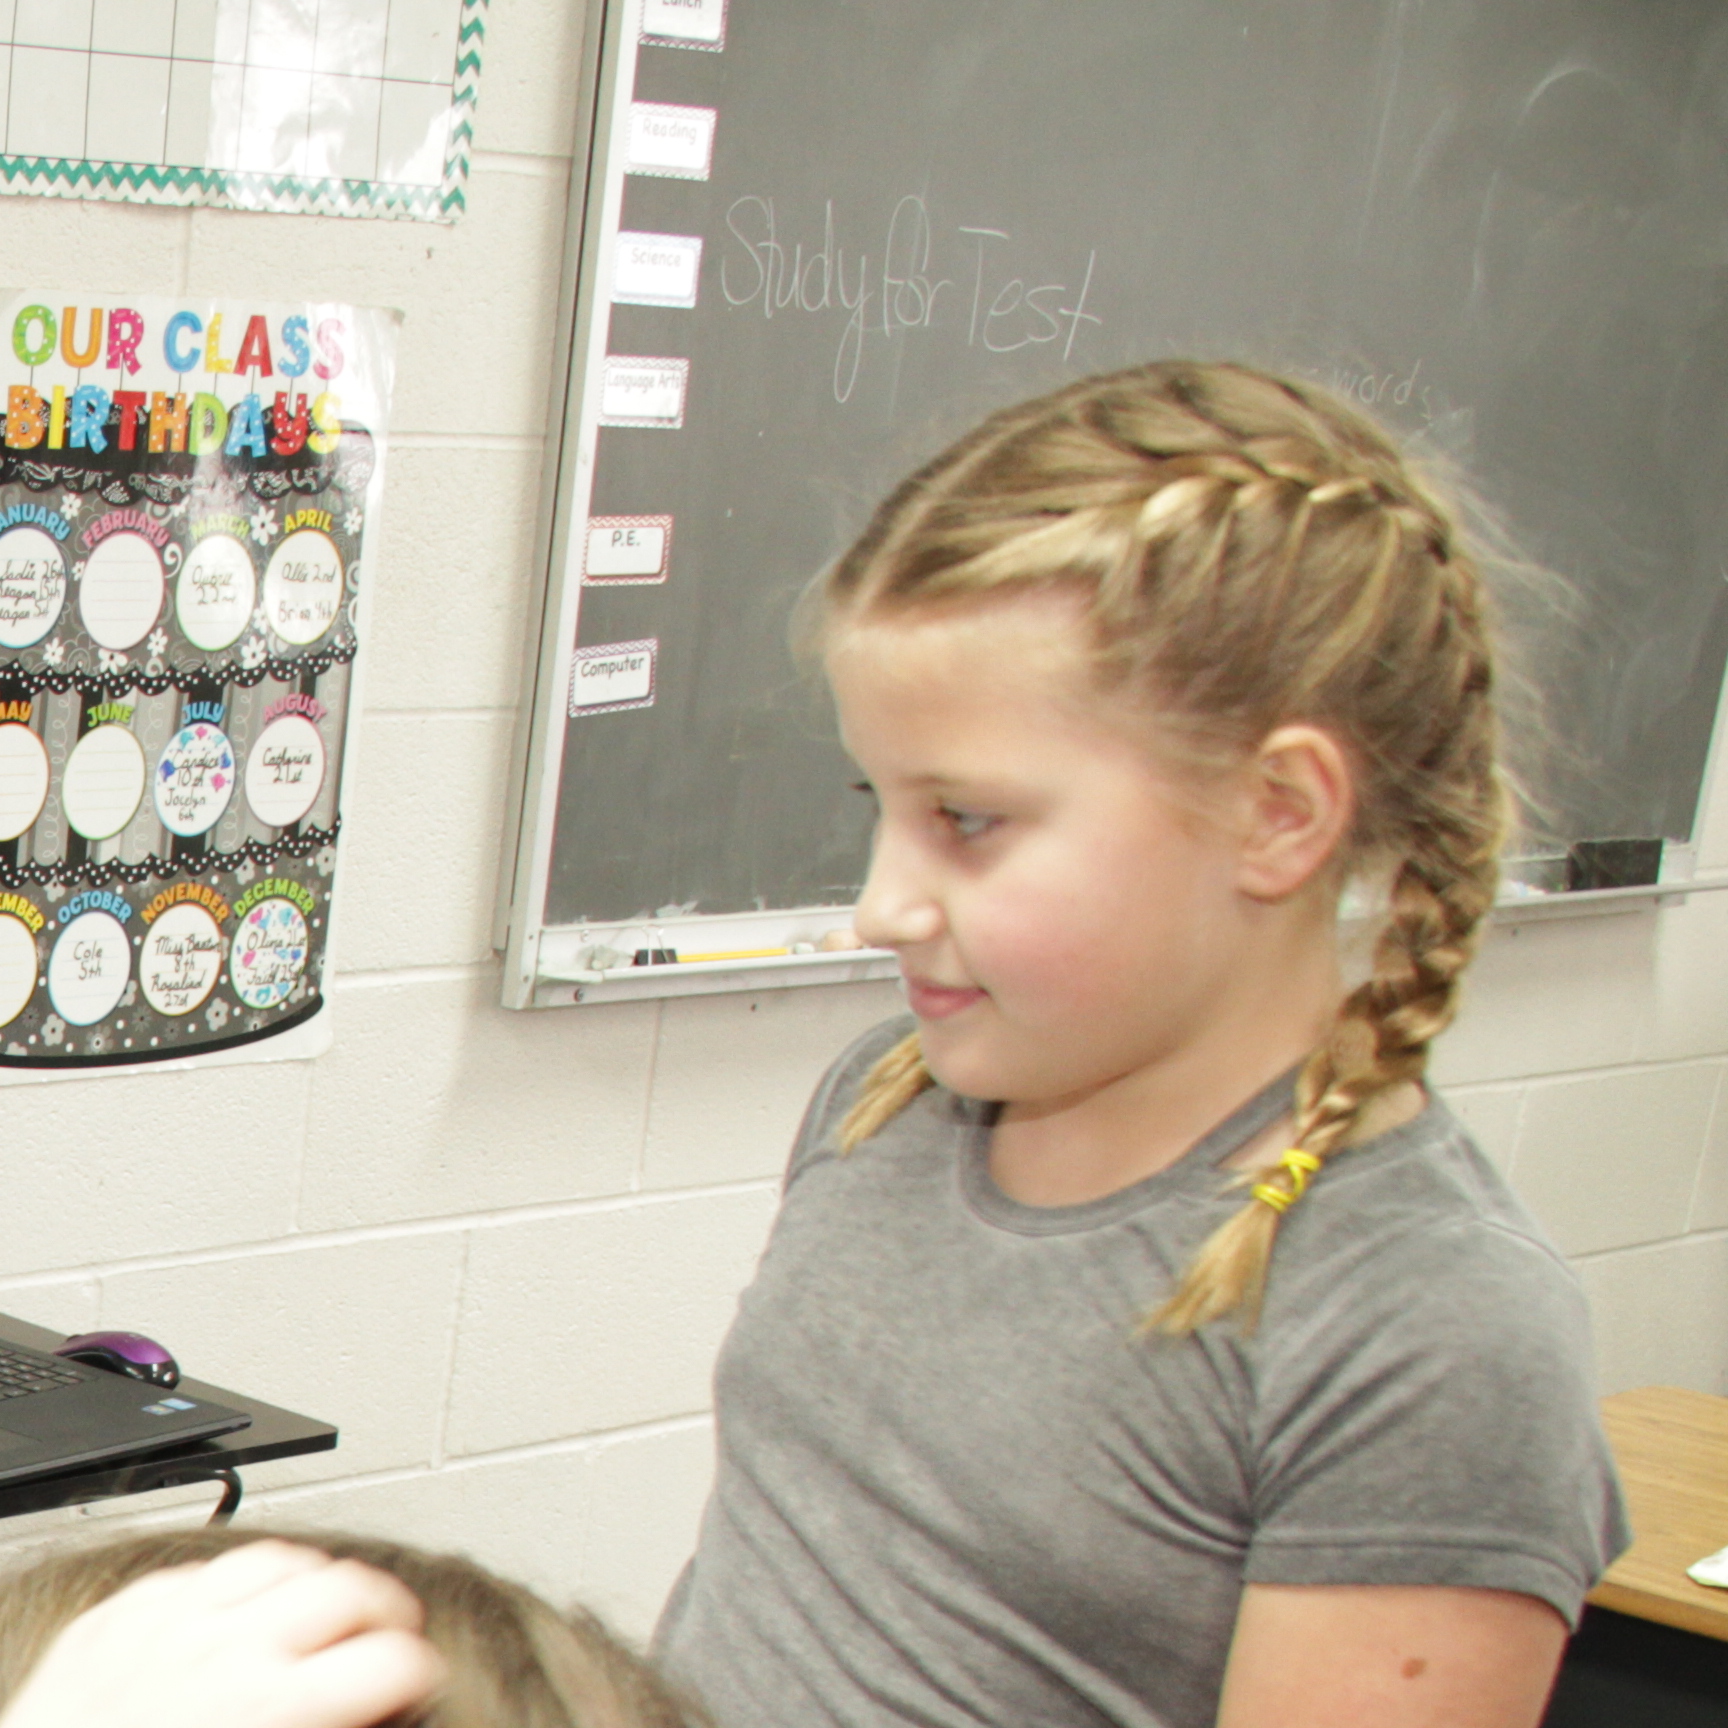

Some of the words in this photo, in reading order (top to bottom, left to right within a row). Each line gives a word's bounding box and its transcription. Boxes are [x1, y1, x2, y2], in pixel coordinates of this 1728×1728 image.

[643, 117, 697, 146] Reading
[631, 246, 681, 268] Science
[721, 195, 873, 404] Study
[883, 194, 953, 338] for
[959, 226, 1103, 362] Test
[11, 303, 145, 377] OUR
[163, 310, 347, 381] CLASS
[608, 370, 655, 394] Language
[658, 372, 680, 389] Arts
[4, 383, 343, 458] BIRTHDAYS
[82, 509, 171, 550] FEBRUARY
[190, 512, 251, 541] MARCH
[284, 508, 334, 533] APRIL
[610, 529, 641, 548] P.E.
[312, 563, 337, 583] 2nd
[580, 656, 645, 681] Computer
[87, 702, 135, 727] JUNE
[181, 701, 226, 724] JULY
[262, 692, 328, 723] AUGUST
[57, 890, 132, 924] OCTOBER
[140, 882, 230, 925] NOVEMBER
[232, 878, 315, 918] DECEMBER
[73, 940, 103, 960] Cole
[78, 960, 102, 981] 5th
